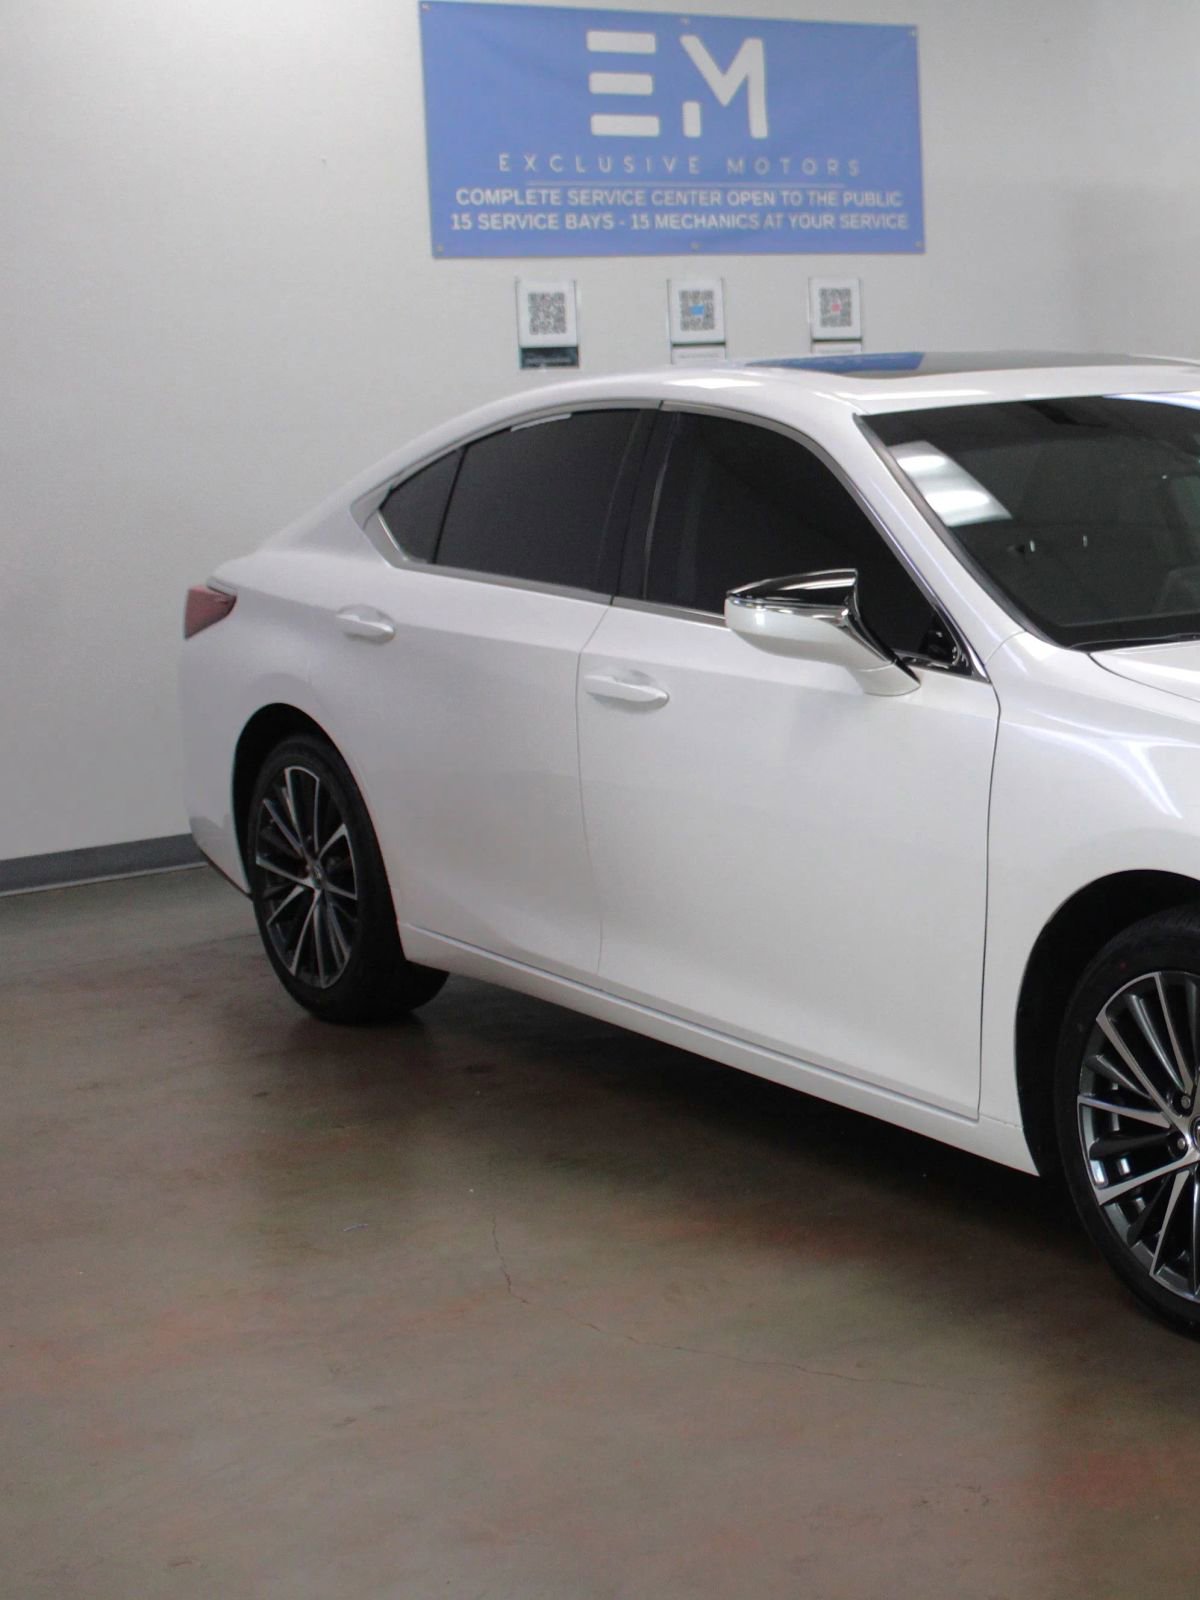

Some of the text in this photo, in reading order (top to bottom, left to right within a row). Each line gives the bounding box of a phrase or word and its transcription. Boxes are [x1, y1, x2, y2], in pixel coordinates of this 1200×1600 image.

[586, 30, 769, 139] EM
[499, 153, 860, 177] EXCLUSIVE MOTORS
[456, 187, 903, 208] COMPLETE SERVICE CENTER OPEN TO THE PUBLIC
[451, 213, 472, 230] 15
[478, 213, 560, 231] SERVICE
[565, 213, 614, 230] BAYS
[631, 213, 650, 230] 15
[654, 213, 759, 231] MECHANICS
[763, 213, 785, 230] AT
[788, 213, 835, 230] YOUR
[839, 213, 908, 230] SERVICE
